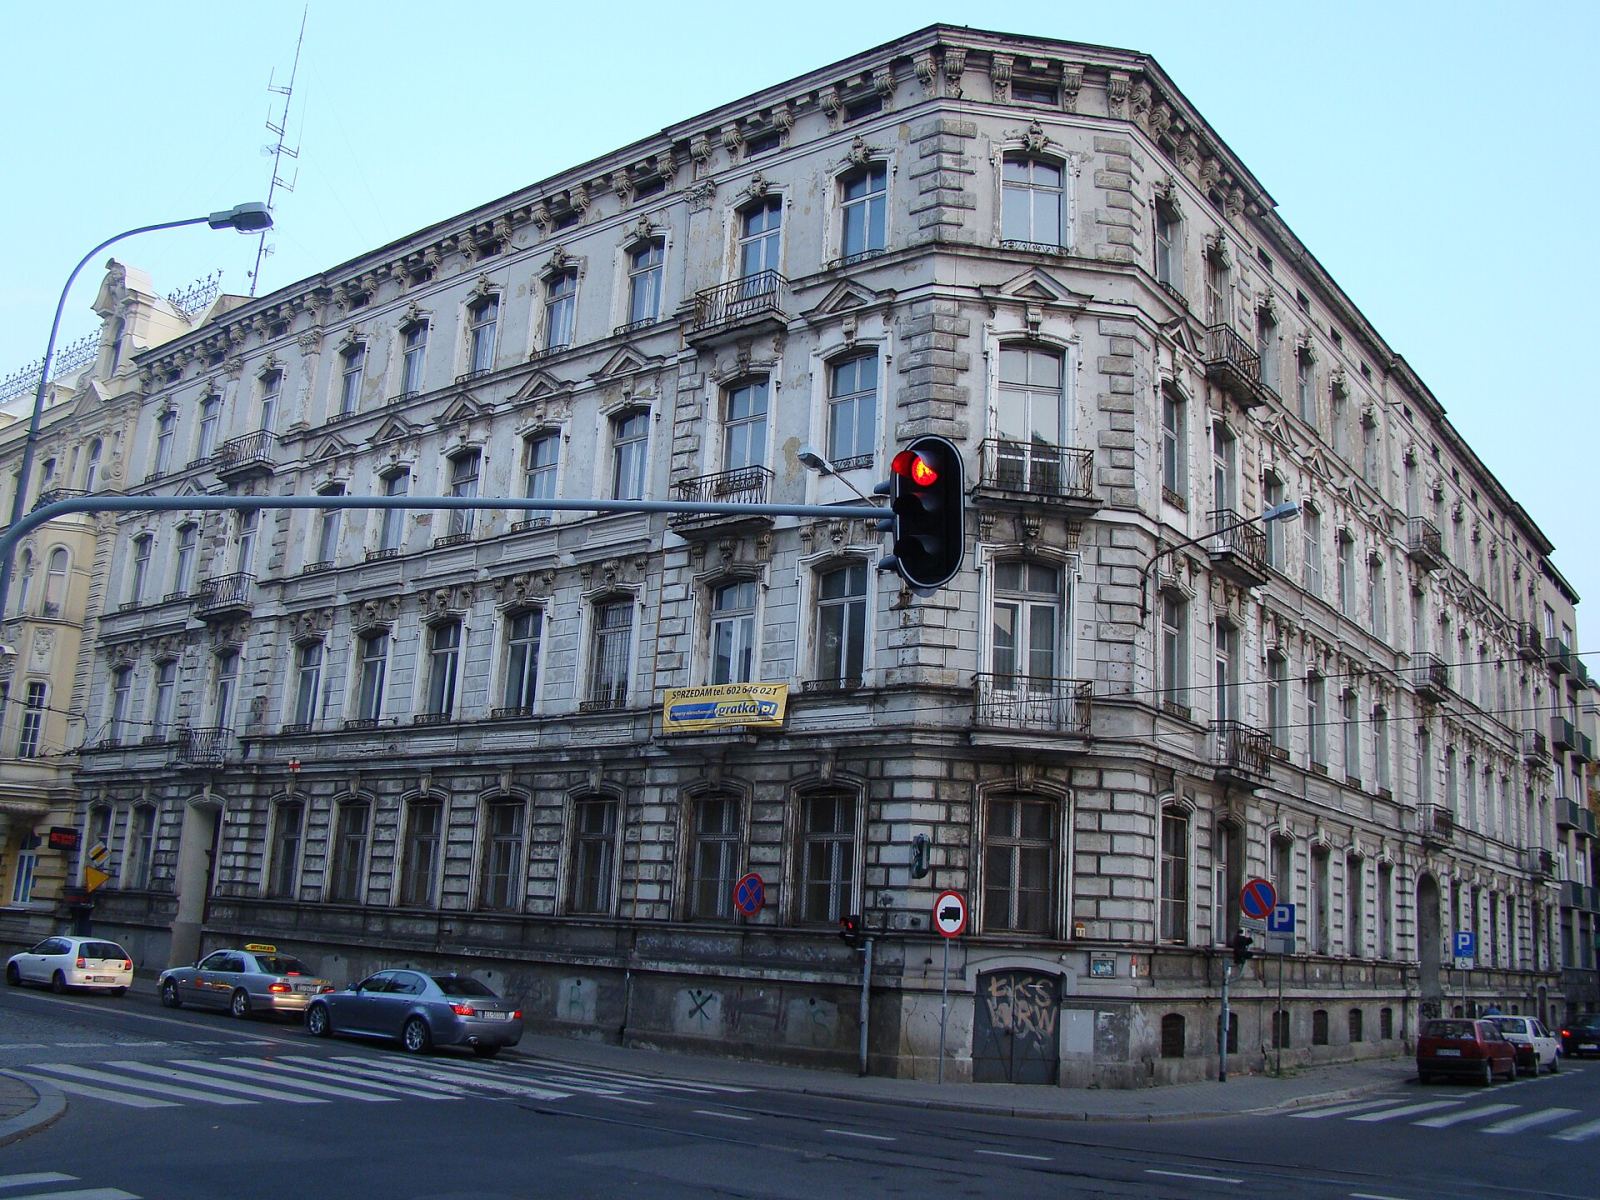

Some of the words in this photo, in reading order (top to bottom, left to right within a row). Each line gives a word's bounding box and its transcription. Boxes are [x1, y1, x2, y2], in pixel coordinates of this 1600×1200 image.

[672, 688, 712, 700] SPRZEDAM
[713, 686, 725, 696] tel.
[727, 686, 740, 695] 602
[760, 686, 777, 696] 021
[719, 701, 756, 716] gratka
[1273, 906, 1290, 929] P
[1458, 934, 1471, 950] P
